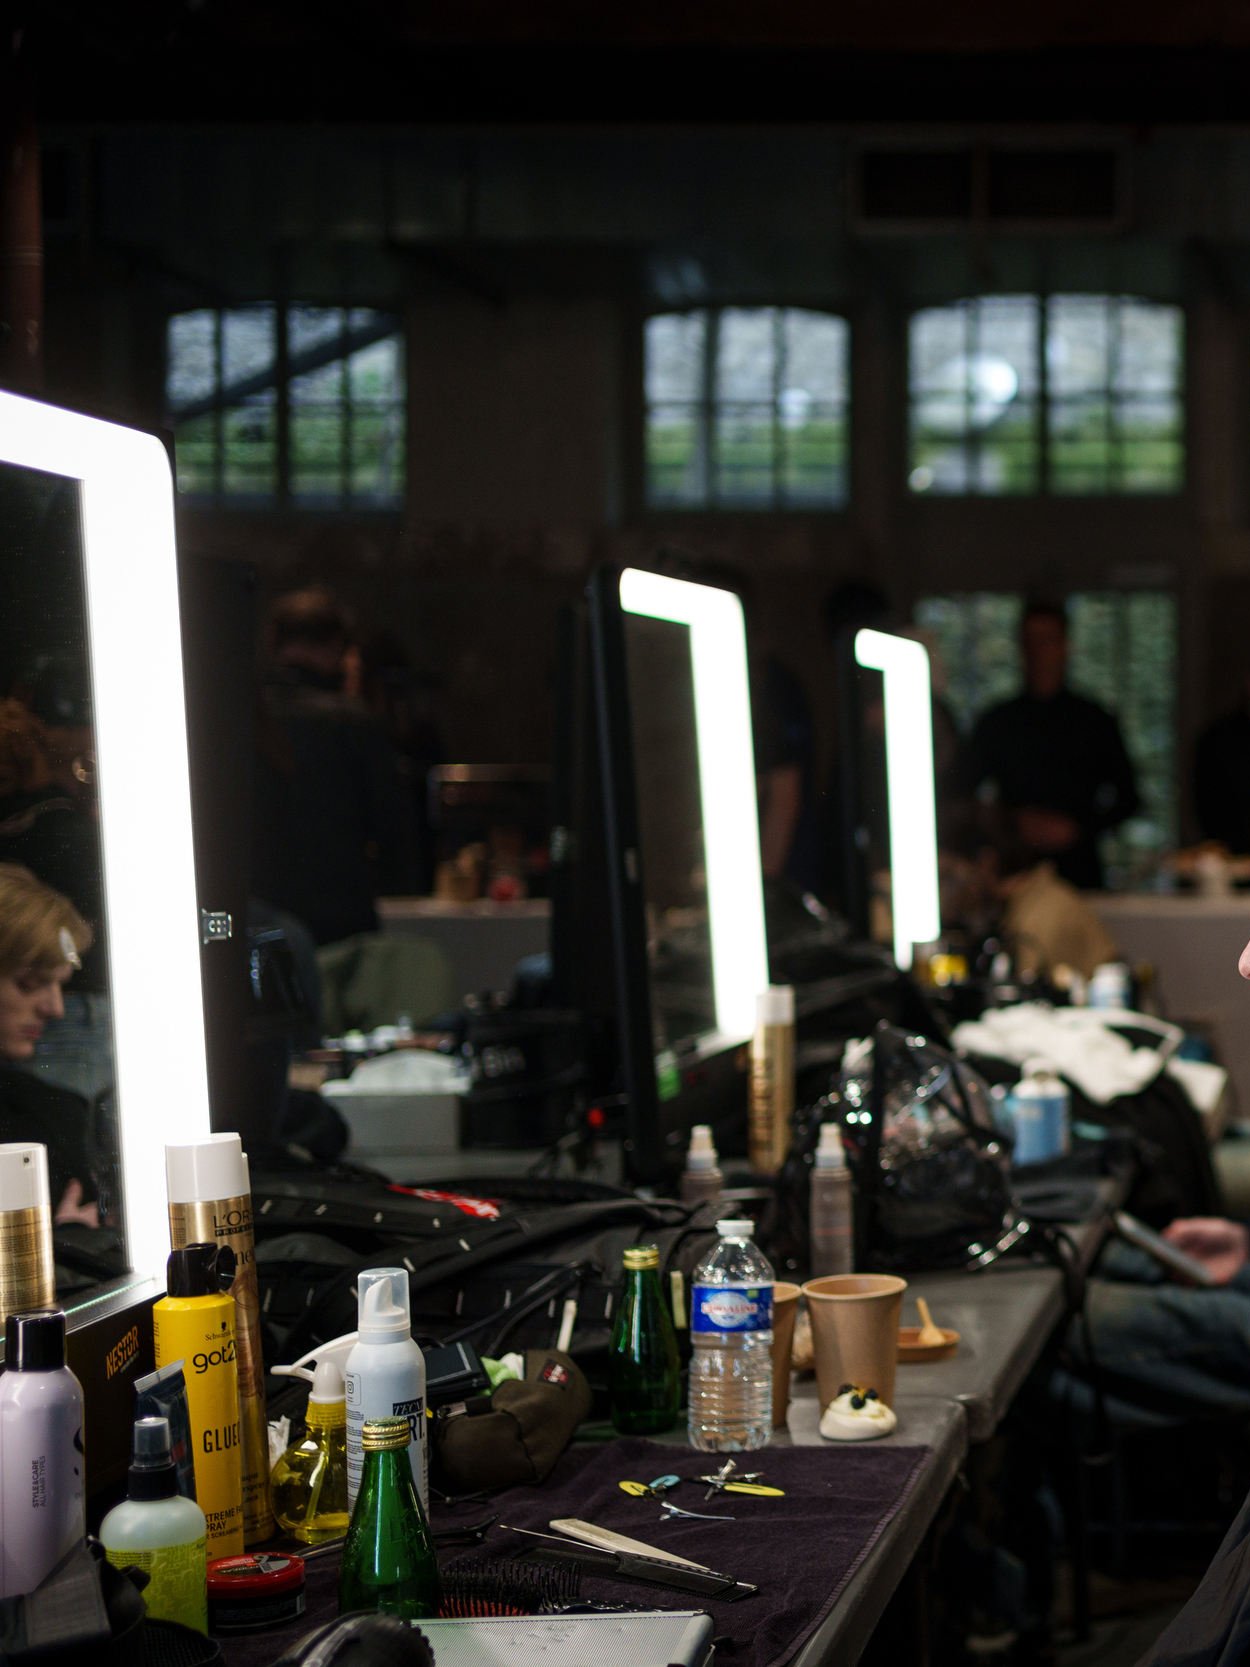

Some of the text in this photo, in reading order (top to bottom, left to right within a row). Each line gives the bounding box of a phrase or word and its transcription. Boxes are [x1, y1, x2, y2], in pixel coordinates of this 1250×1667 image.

[213, 1209, 253, 1228] L'OR
[106, 1325, 139, 1380] NESTOR
[408, 1412, 425, 1441] RT.
[205, 1507, 235, 1522] XTREME
